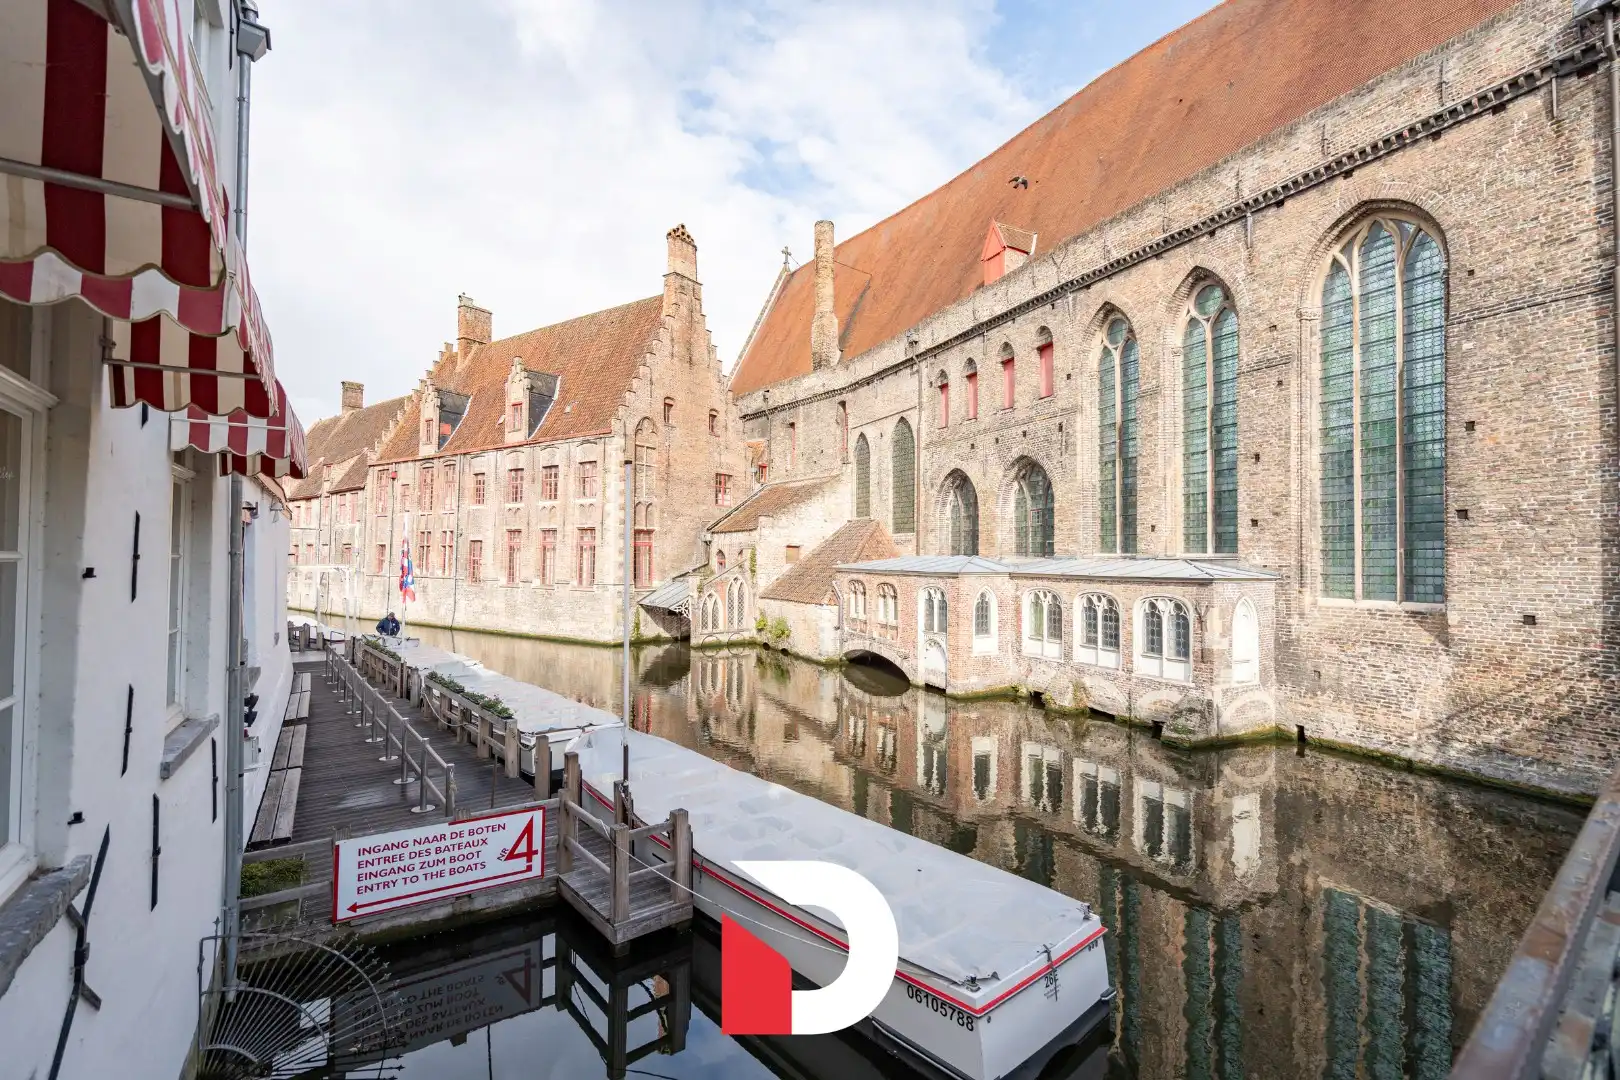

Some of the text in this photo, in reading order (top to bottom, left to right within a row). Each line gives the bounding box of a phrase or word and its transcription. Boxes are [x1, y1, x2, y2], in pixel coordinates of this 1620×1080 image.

[357, 838, 488, 869] ENTREE DES BATEAUX
[358, 823, 506, 856] INGANG NAAR DE BOTEN
[497, 815, 538, 863] NR 4
[357, 850, 481, 882] EINGANG ZUM BOOT
[357, 861, 487, 895] ENTRY TO THE BOATS
[907, 984, 974, 1032] 06105788
